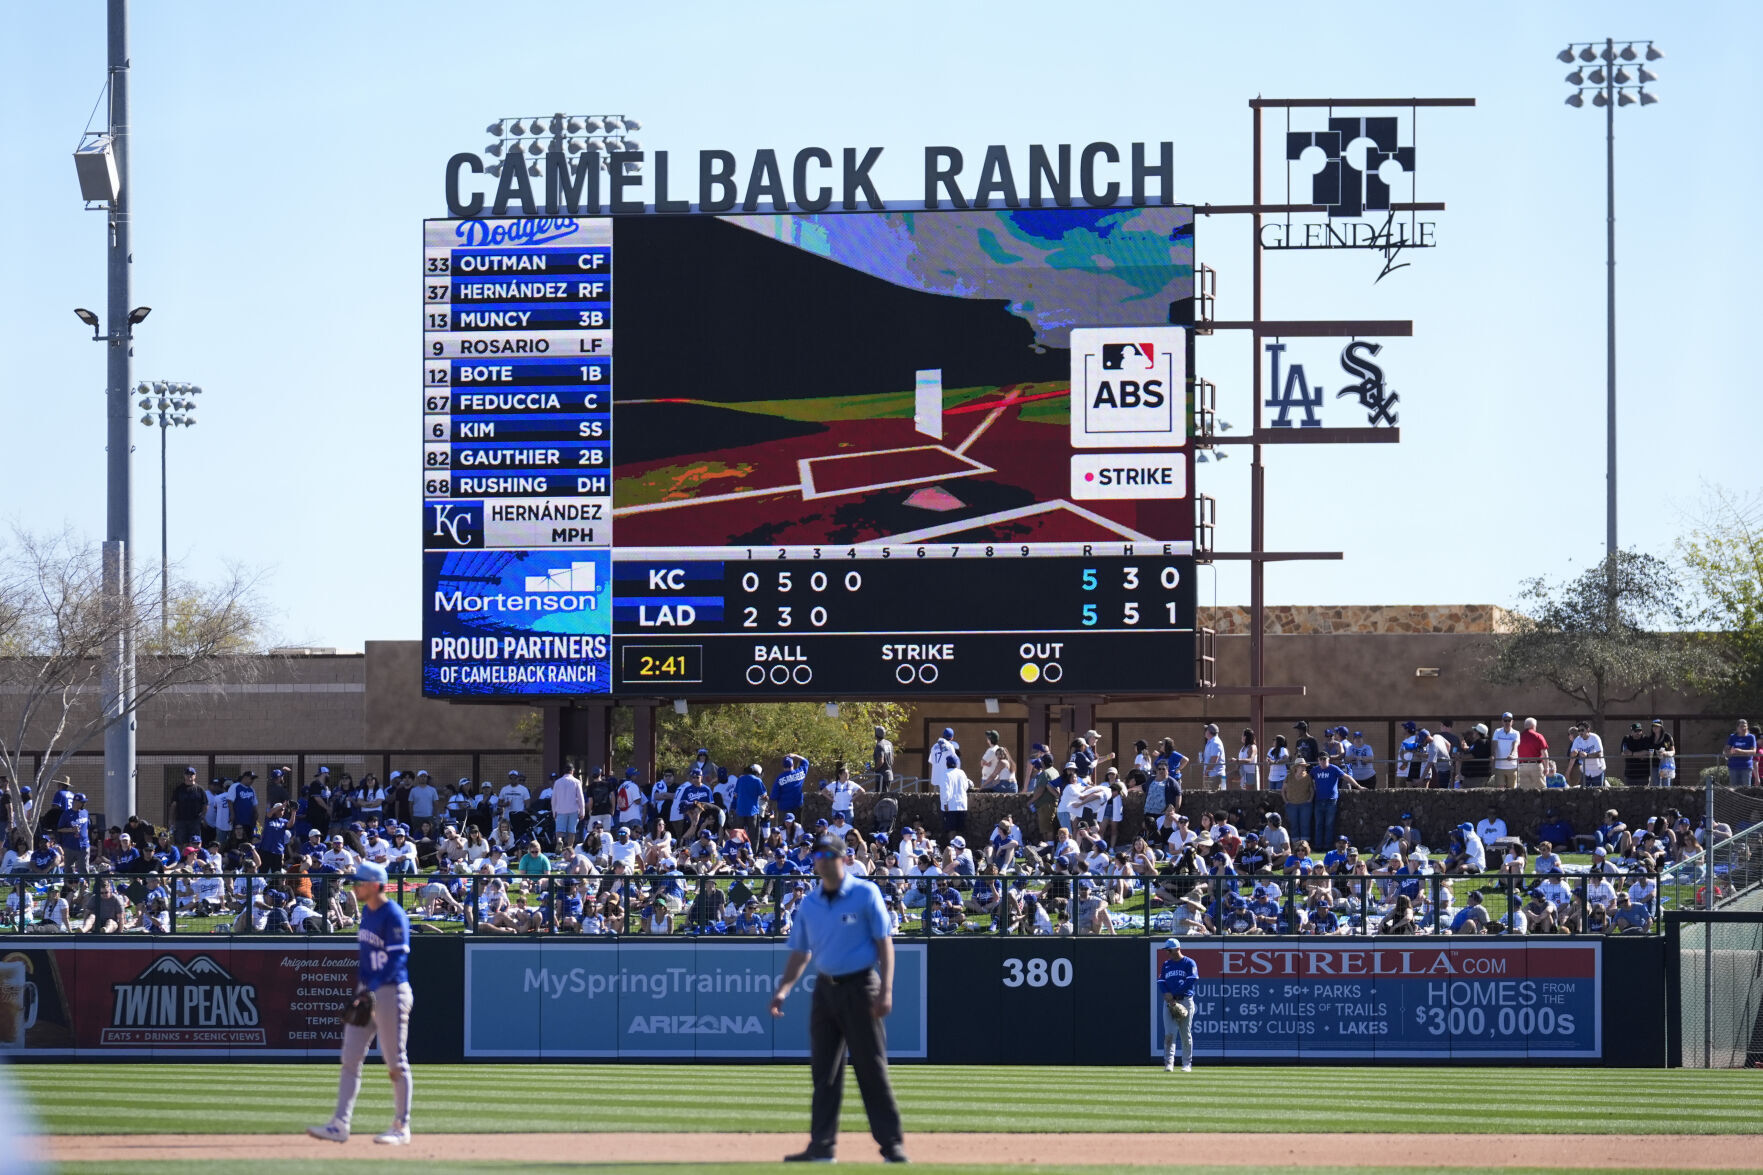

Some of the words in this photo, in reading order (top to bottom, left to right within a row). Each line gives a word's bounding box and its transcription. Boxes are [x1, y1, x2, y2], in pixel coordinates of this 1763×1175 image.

[445, 146, 885, 217] CAMELBACK
[925, 141, 1174, 210] RANCH
[455, 218, 579, 246] Dodgers
[428, 258, 449, 272] 33
[460, 255, 546, 271] OUTMAN
[578, 254, 604, 269] CF
[428, 286, 449, 300] 37
[460, 280, 568, 299] HERNÁNDEZ
[579, 283, 604, 298] RF
[429, 314, 448, 328] 13
[460, 312, 531, 327] MUNCY
[579, 311, 603, 326] 3B
[433, 342, 444, 356] 9
[460, 339, 549, 354] ROSARIO
[580, 339, 602, 353] LF
[429, 369, 448, 383] 12
[460, 366, 513, 382] BOTE
[580, 366, 602, 381] 1B
[1265, 343, 1324, 428] LA
[427, 396, 450, 410] 67
[460, 394, 560, 410] FEDUCCIA
[584, 394, 597, 409] C
[1093, 380, 1164, 409] ABS
[432, 423, 444, 438] 6
[460, 423, 495, 438] KIM
[579, 421, 603, 437] SS
[427, 452, 450, 466] 82
[460, 450, 560, 466] GAUTHIER
[579, 450, 603, 465] 2B
[1099, 467, 1173, 485] STRIKE
[426, 480, 450, 494] 68
[460, 478, 548, 494] RUSHING
[577, 478, 605, 492] DH
[492, 501, 602, 522] HERNÁNDEZ
[433, 504, 471, 545] KC
[551, 528, 594, 543] MPH
[747, 548, 752, 559] 1
[778, 549, 787, 559] 2
[813, 548, 821, 559] 3
[847, 548, 857, 559] 4
[882, 547, 891, 559] 5
[916, 547, 926, 558] 6
[951, 547, 960, 558] 7
[985, 546, 994, 557] 8
[1021, 546, 1030, 557] 9
[1083, 545, 1093, 556] R
[1124, 545, 1134, 556] H
[1163, 544, 1172, 555] E
[649, 569, 686, 590] KC
[742, 572, 759, 592] 0
[777, 572, 792, 592] 5
[810, 571, 828, 592] 0
[844, 571, 862, 592] 0
[1082, 568, 1098, 591] 5
[1122, 567, 1139, 590] 3
[1160, 566, 1180, 589] 0
[434, 591, 596, 612] Mortenson
[639, 605, 696, 627] LAD
[743, 606, 758, 627] 2
[777, 606, 792, 627] 3
[810, 606, 828, 627] 0
[1082, 603, 1098, 626] 5
[1122, 602, 1140, 625] 5
[1165, 601, 1176, 624] 1
[431, 637, 498, 660] PROUD
[504, 636, 607, 659] PARTNERS
[754, 645, 808, 662] BALL
[881, 644, 954, 660] STRIKE
[1019, 642, 1064, 659] OUT
[640, 656, 686, 675] 2:41
[440, 667, 460, 683] OF
[461, 666, 546, 683] CAMELBACK
[548, 666, 596, 682] RANCH
[280, 956, 319, 971] Arizona
[322, 957, 360, 967] Location
[1218, 951, 1459, 974] ESTRELLA
[1463, 958, 1506, 974] COM
[301, 973, 348, 982] PHOENIX
[1002, 957, 1074, 988] 380
[296, 988, 353, 996] GLENDALE
[1194, 984, 1260, 998] UILDERS
[1283, 985, 1310, 998] 50+
[1314, 985, 1362, 998] PARKS
[1428, 981, 1537, 1006] HOMES
[1542, 983, 1576, 993] FROM
[1542, 994, 1566, 1004] THE
[114, 985, 178, 1026] TWIN
[183, 985, 259, 1026] PEAKS
[290, 1002, 345, 1011] SCOTTSDA
[1239, 1003, 1266, 1016] 65+
[1270, 1003, 1316, 1016] MILES
[1318, 1003, 1332, 1012] OF
[1335, 1003, 1388, 1016] TRAILS
[305, 1016, 340, 1025] TEMPE
[628, 1015, 765, 1034] ARIZONA
[1191, 1020, 1262, 1034] SIDENTS'
[1266, 1021, 1316, 1034] CLUBS
[1339, 1021, 1389, 1035] LAKES
[1415, 1005, 1576, 1039] $300,000s
[108, 1033, 131, 1041] EATS
[145, 1033, 180, 1041] DRINKS
[193, 1033, 228, 1041] SCENIC
[228, 1033, 260, 1041] VIEWS
[289, 1032, 317, 1040] DEER
[320, 1032, 345, 1040] VALL
